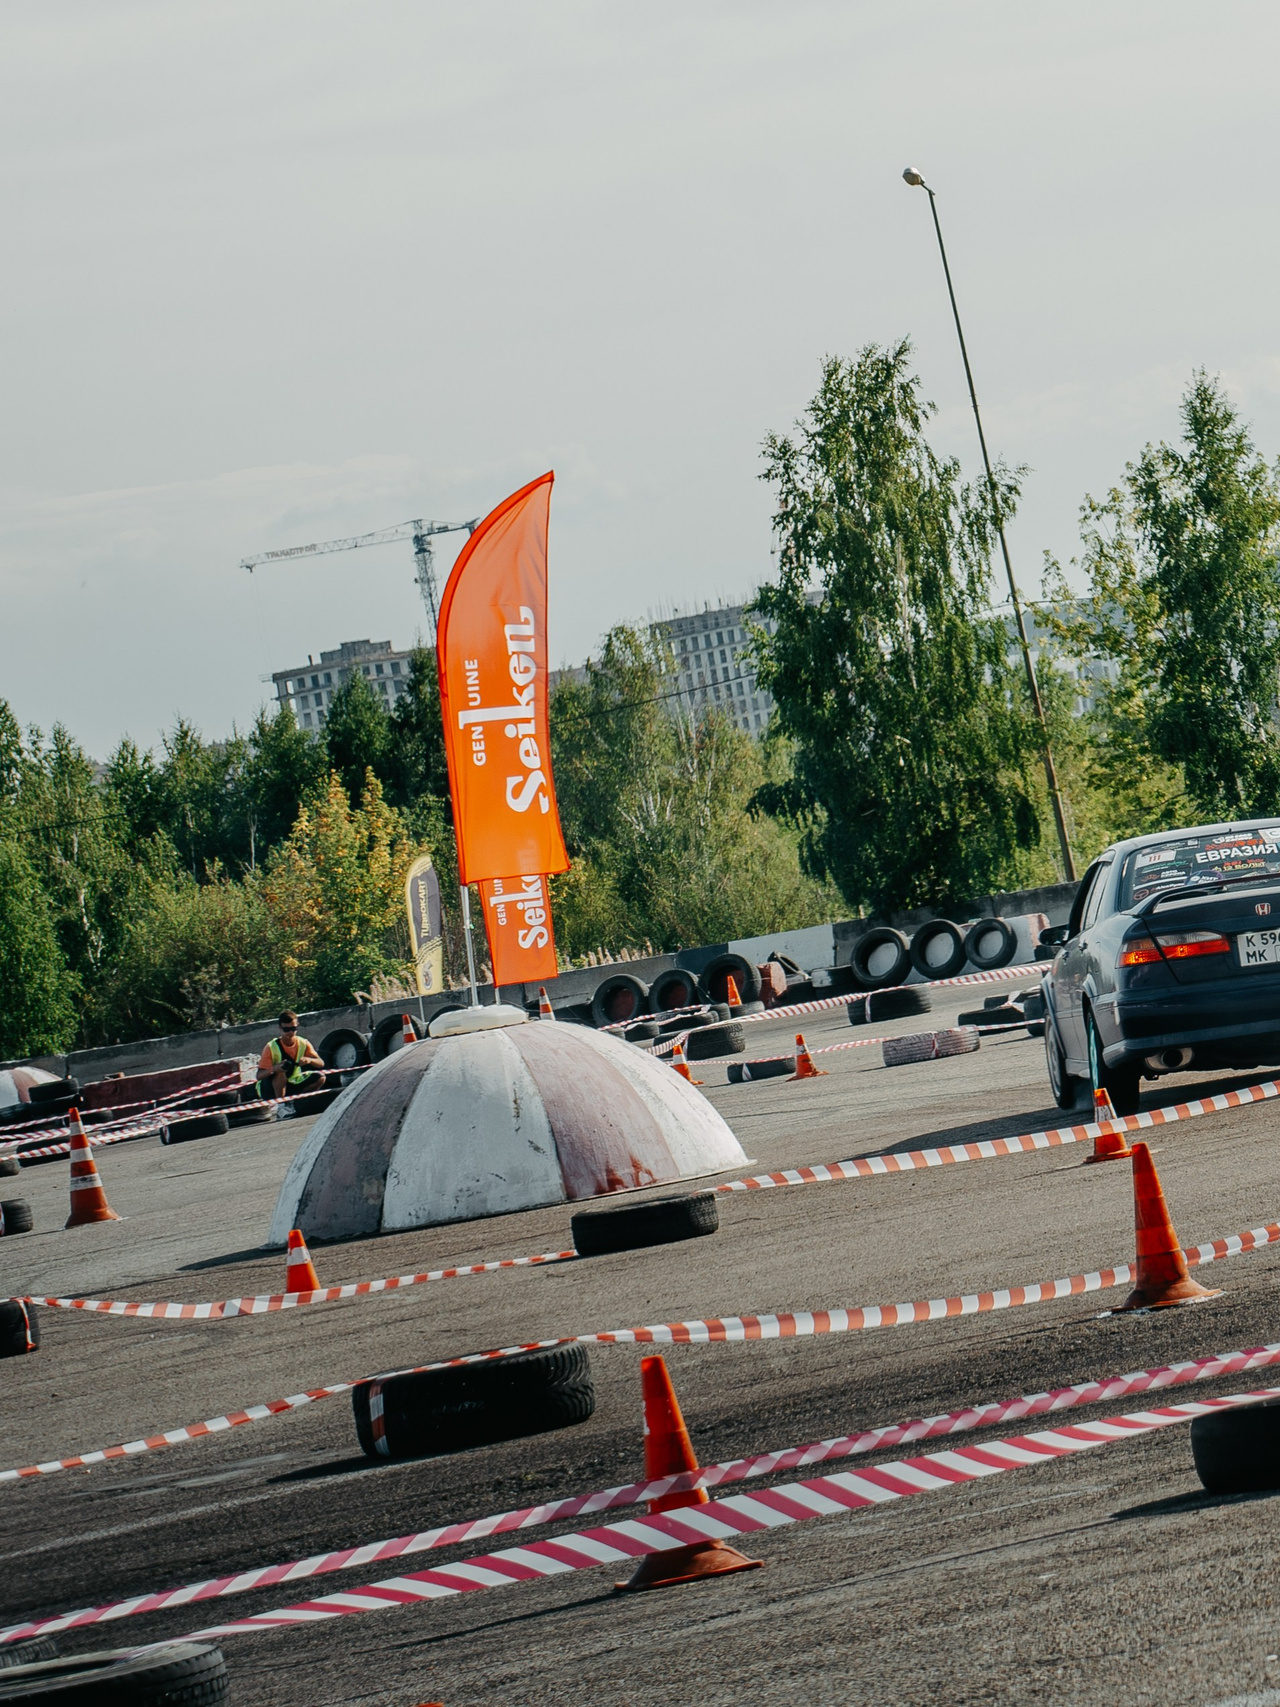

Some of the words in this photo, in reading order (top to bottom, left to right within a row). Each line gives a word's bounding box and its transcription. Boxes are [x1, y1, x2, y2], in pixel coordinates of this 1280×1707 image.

[458, 605, 550, 815] Seiken
[1195, 843, 1279, 864] ЕВРАЗИЯ
[418, 879, 430, 938] TURBOKART
[489, 875, 549, 949] Seik
[1246, 950, 1268, 963] МК
